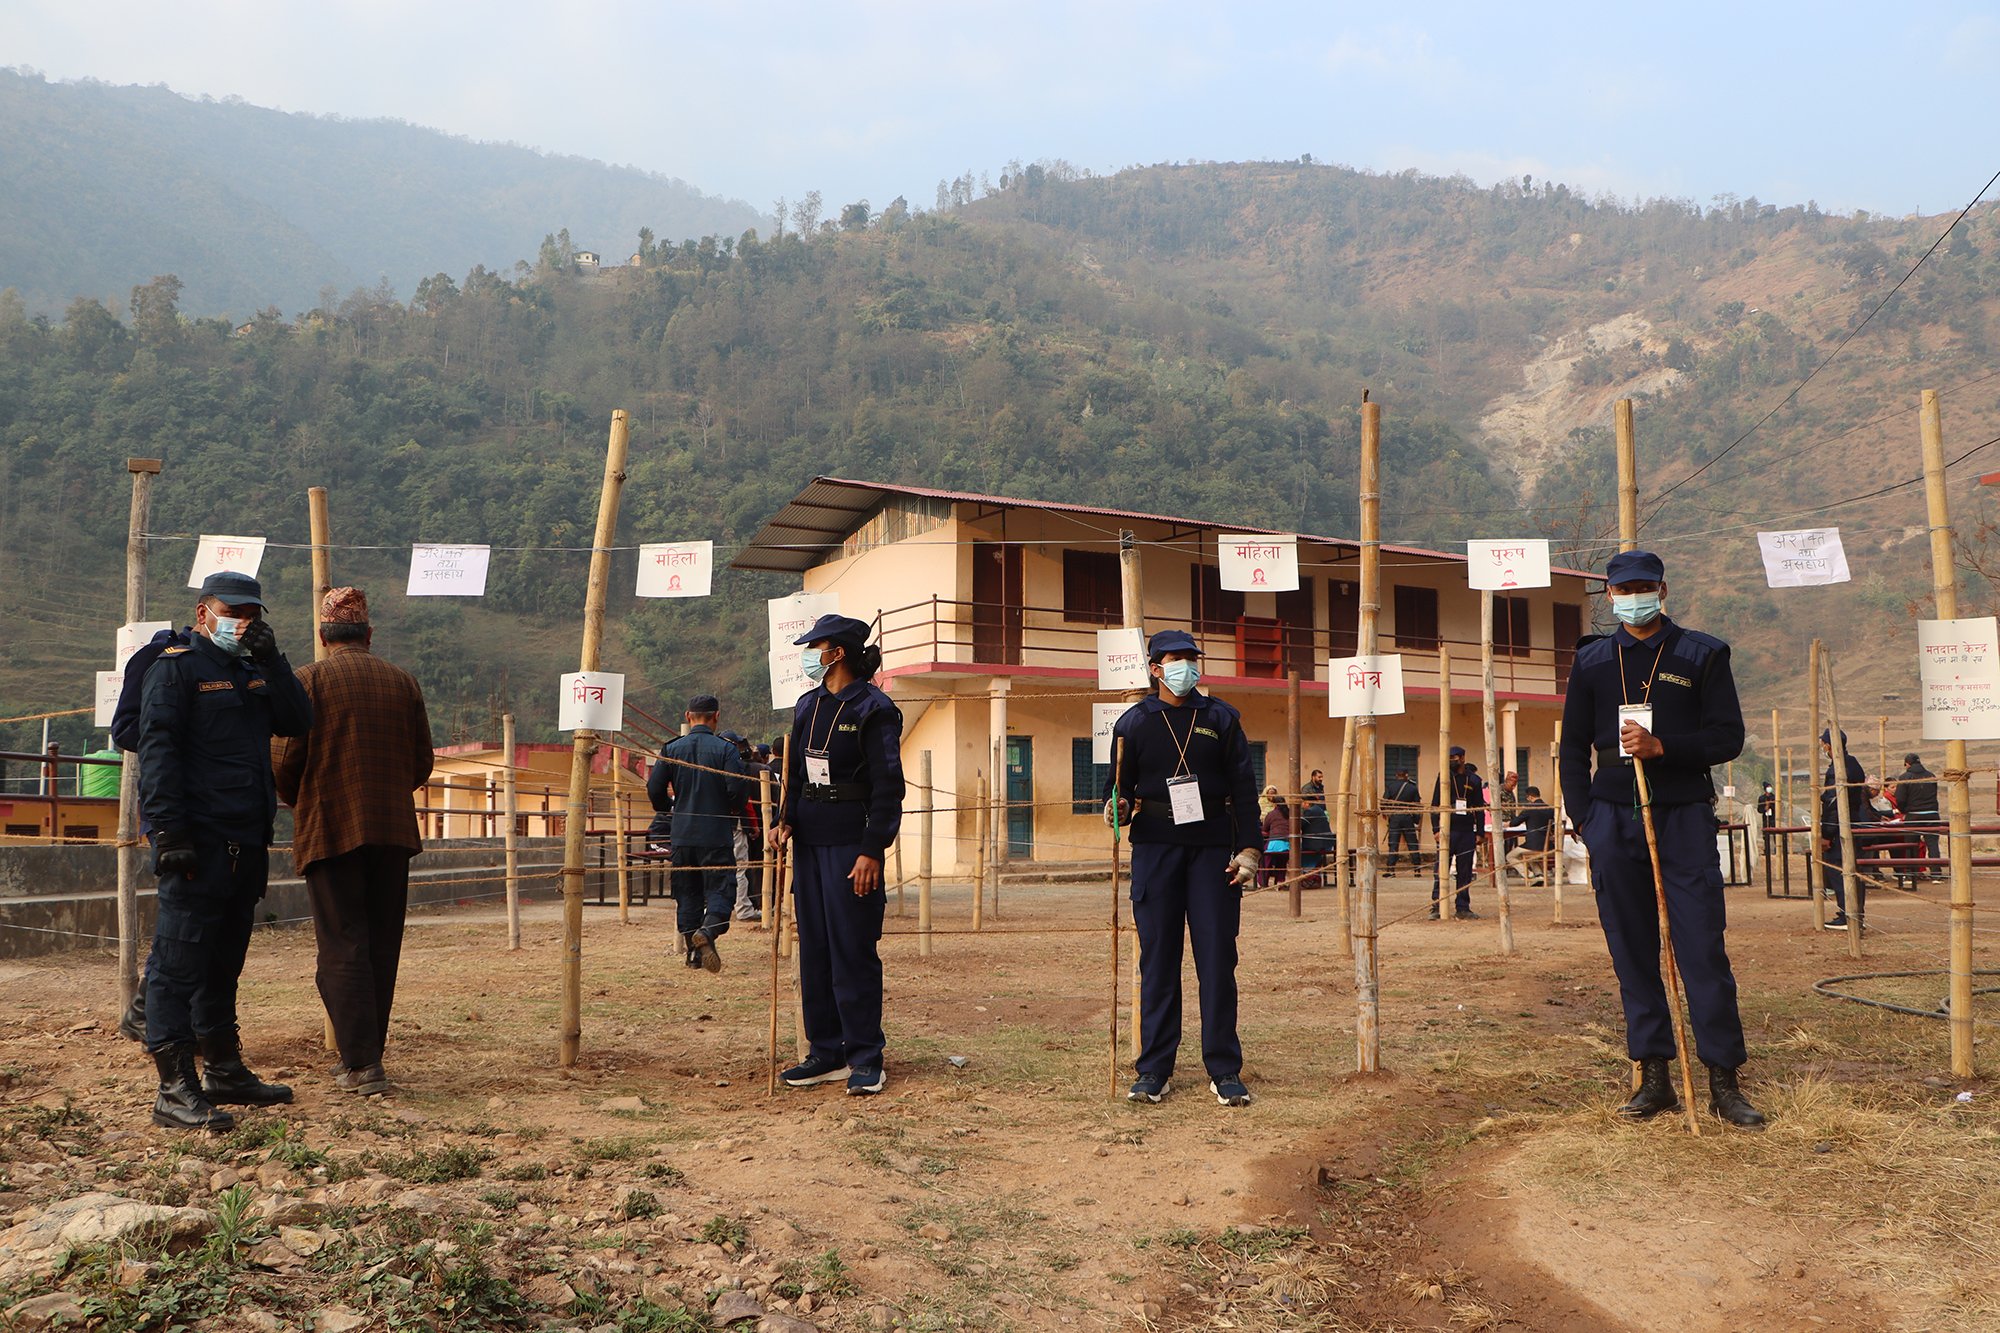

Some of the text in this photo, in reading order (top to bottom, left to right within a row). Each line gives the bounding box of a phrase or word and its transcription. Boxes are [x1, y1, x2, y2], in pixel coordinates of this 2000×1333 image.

[1234, 541, 1281, 561] महिला
[655, 548, 698, 568] महिला
[1781, 558, 1829, 570] असहाय
[421, 570, 464, 580] असहाय
[777, 619, 805, 632] मतदान
[1925, 645, 1958, 655] मतदान
[1107, 653, 1139, 664] मतदान
[1347, 665, 1383, 690] भित्र
[573, 679, 607, 704] भित्र
